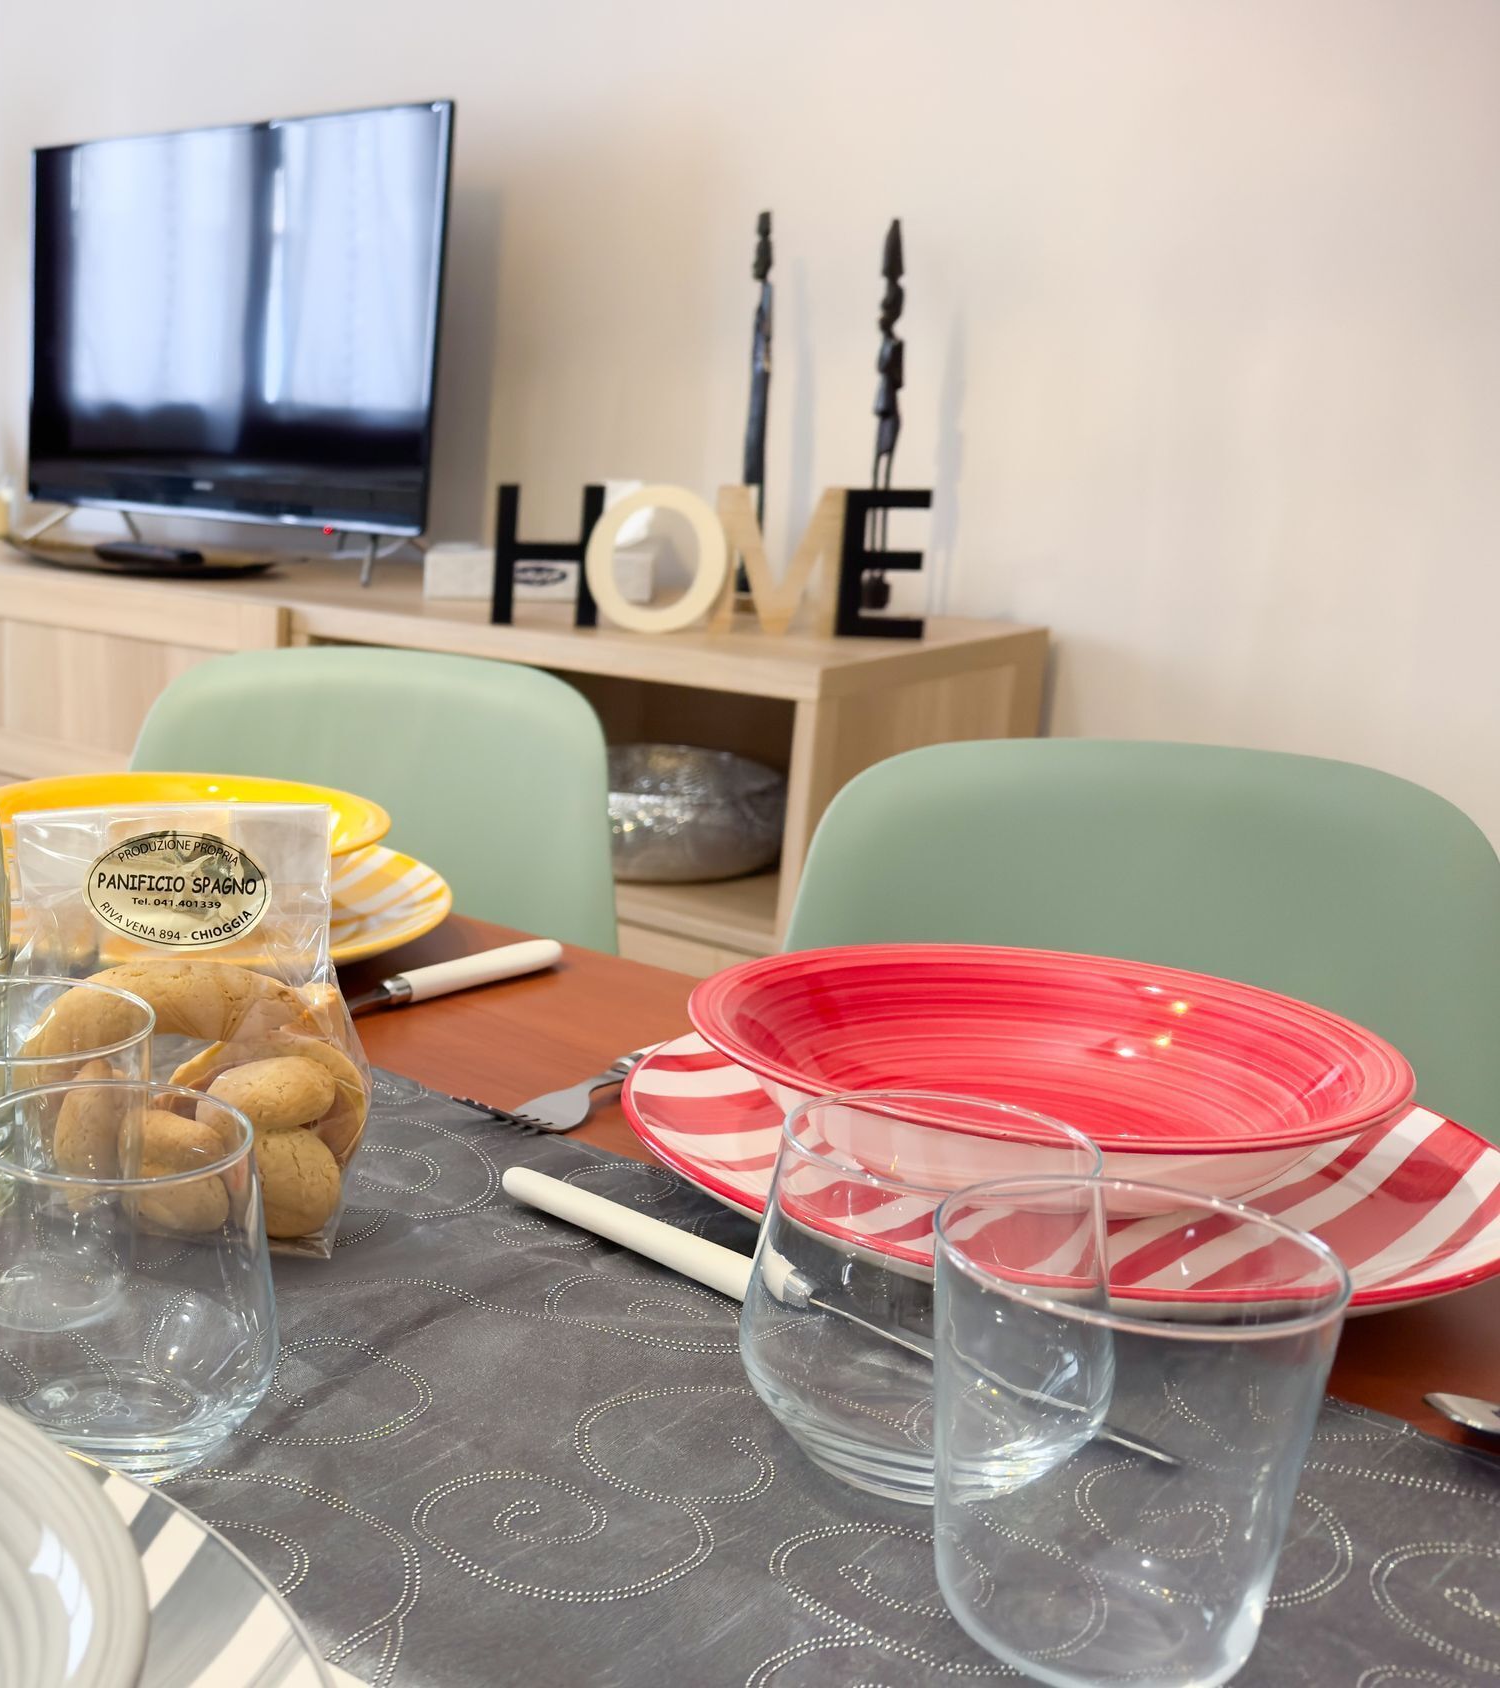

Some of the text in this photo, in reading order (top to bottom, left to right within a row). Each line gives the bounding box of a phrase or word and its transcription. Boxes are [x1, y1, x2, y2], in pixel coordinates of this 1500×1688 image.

[491, 484, 933, 639] HOME
[118, 839, 239, 866] PRODUZIONE PROPRIA
[97, 872, 257, 895] PANIFICIO SPAGNO
[132, 897, 222, 909] Tel. 041.401339
[99, 901, 123, 924] RIVA
[125, 917, 156, 937] VENA
[159, 929, 180, 941] 894
[191, 910, 253, 941] CHIOGGIA
